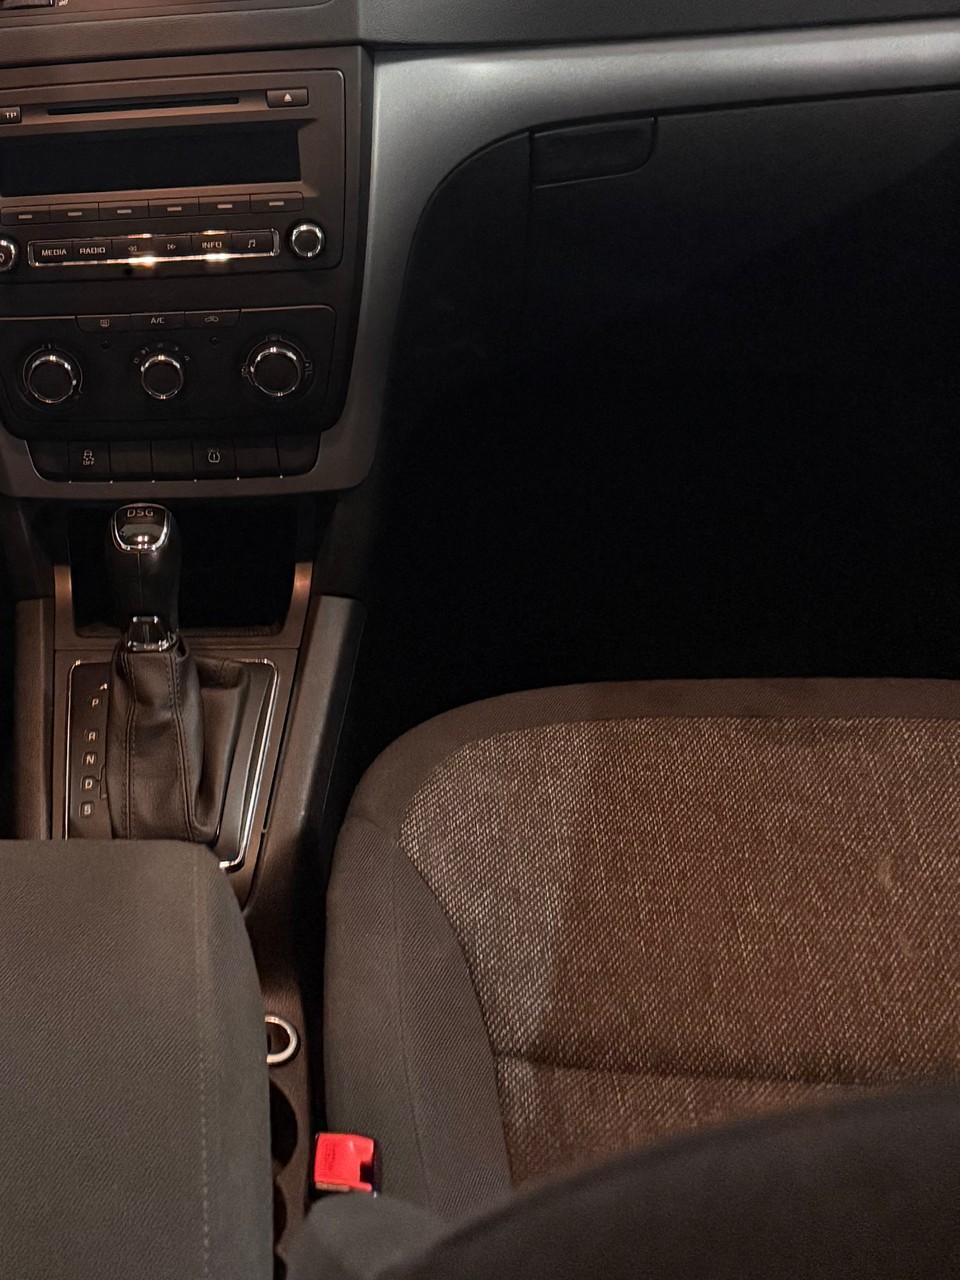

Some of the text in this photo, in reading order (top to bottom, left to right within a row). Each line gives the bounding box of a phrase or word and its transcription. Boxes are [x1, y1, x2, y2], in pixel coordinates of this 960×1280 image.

[4, 111, 17, 119] TP
[201, 240, 223, 249] INFO
[41, 248, 68, 257] MEDIA
[79, 246, 107, 255] RADIO
[150, 316, 166, 325] A/C
[126, 508, 155, 518] DSG
[91, 698, 100, 708] P
[88, 731, 96, 741] R
[86, 754, 95, 765] N
[85, 779, 93, 789] D
